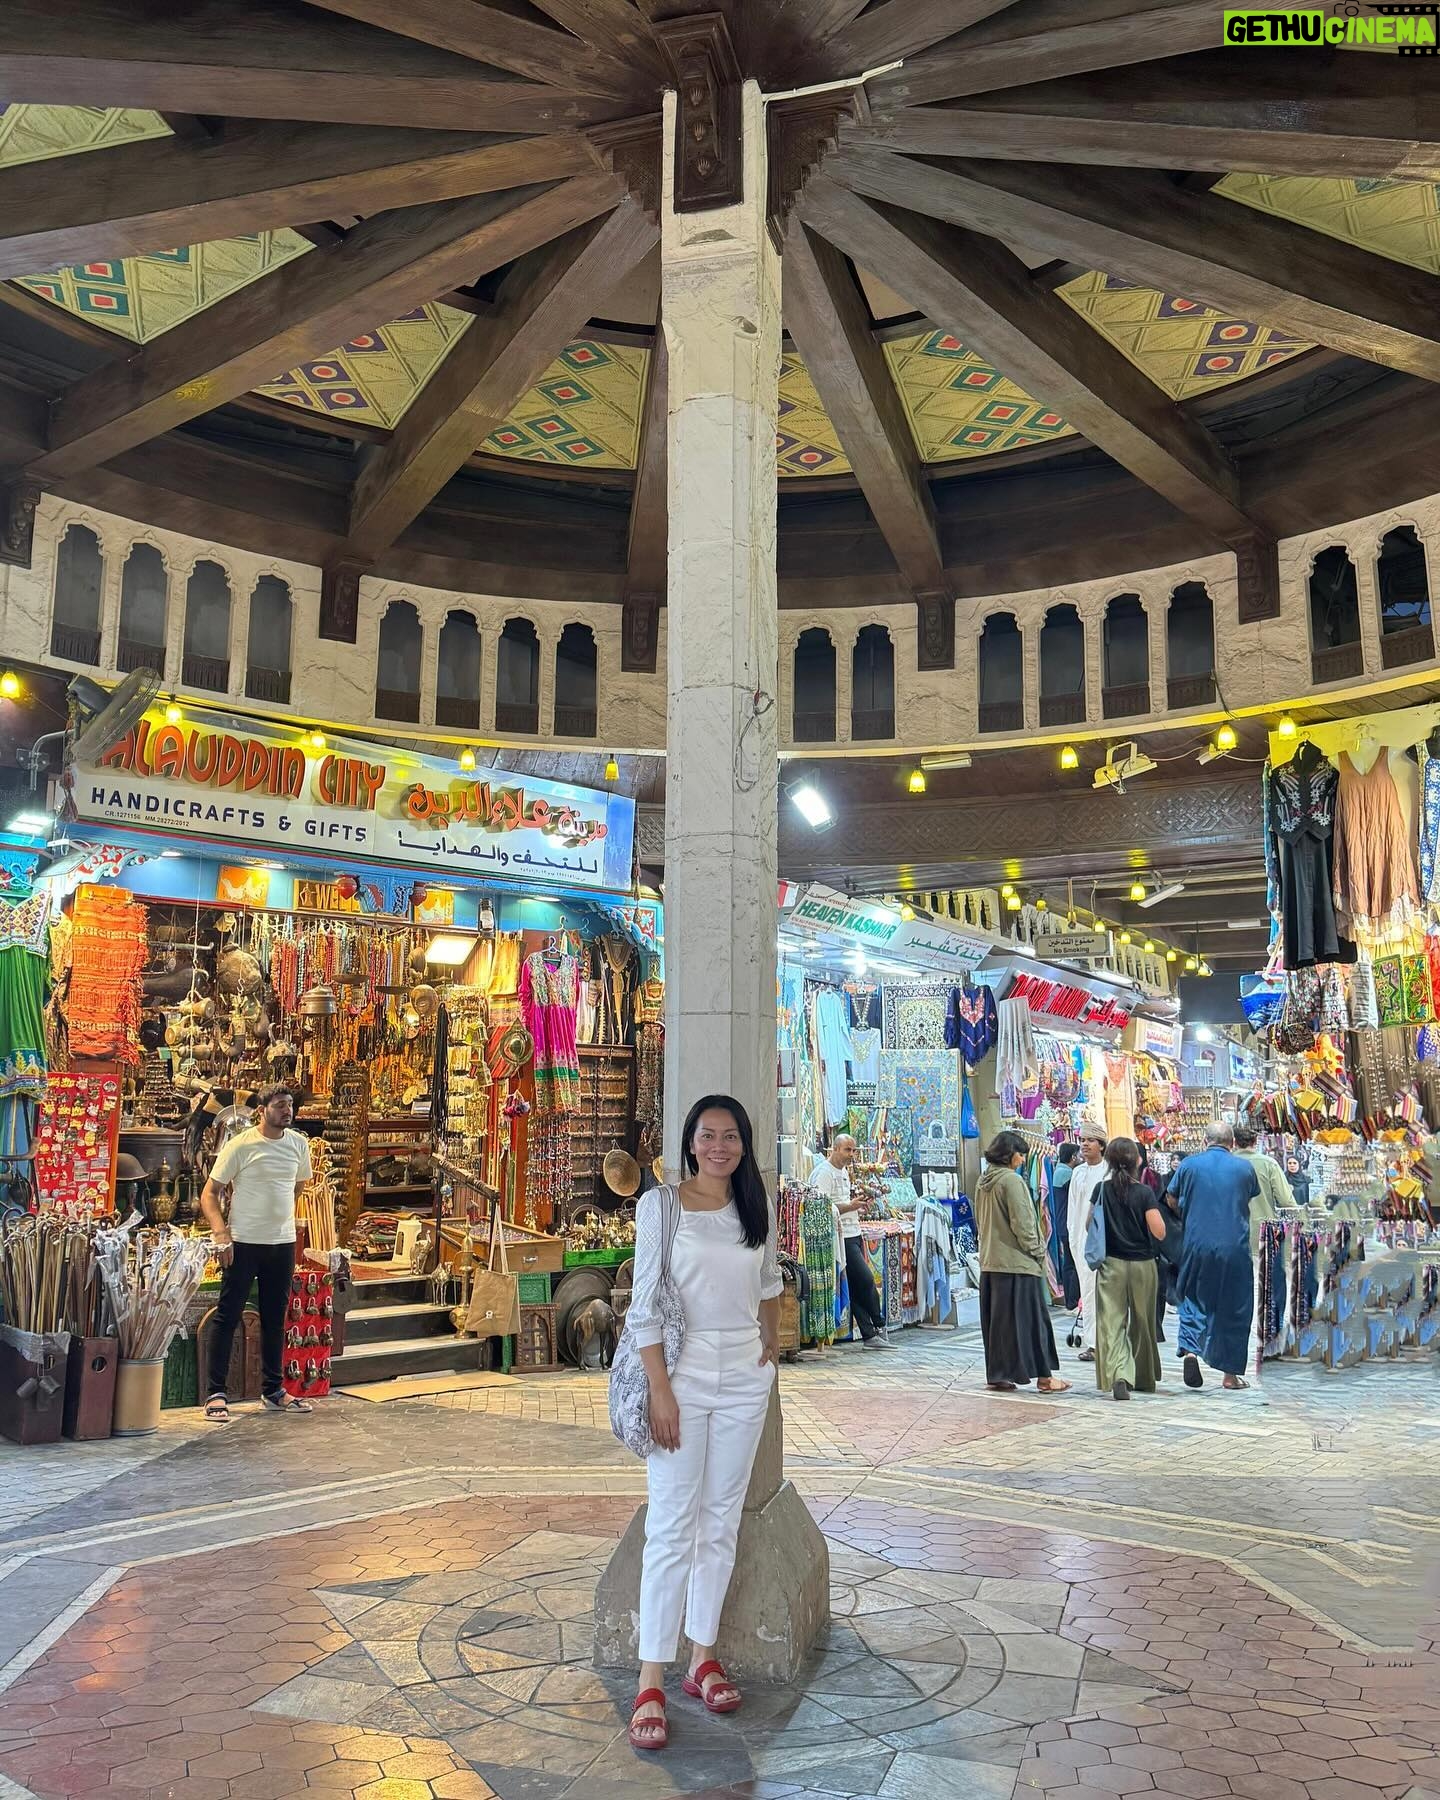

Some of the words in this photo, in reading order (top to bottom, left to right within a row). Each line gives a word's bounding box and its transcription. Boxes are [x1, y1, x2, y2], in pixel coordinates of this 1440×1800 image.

[101, 719, 306, 800] ALAUDDIN
[317, 754, 387, 810] CITY
[90, 786, 265, 828] HANDICRAFTS
[278, 815, 291, 831] &
[304, 819, 367, 842] GIFTS
[407, 780, 492, 831] الدين
[491, 787, 556, 831] علاء
[556, 804, 609, 847] مدينة
[397, 830, 510, 867] والهدايا
[512, 848, 598, 874] للتحف
[796, 899, 849, 926] HEAVEN
[843, 912, 897, 940] KASHMIR
[904, 936, 964, 956] كشمير
[959, 946, 983, 964] جنة
[1047, 938, 1074, 948] التدخين
[1063, 947, 1090, 955] Smoking
[1075, 936, 1095, 947] ممنوع
